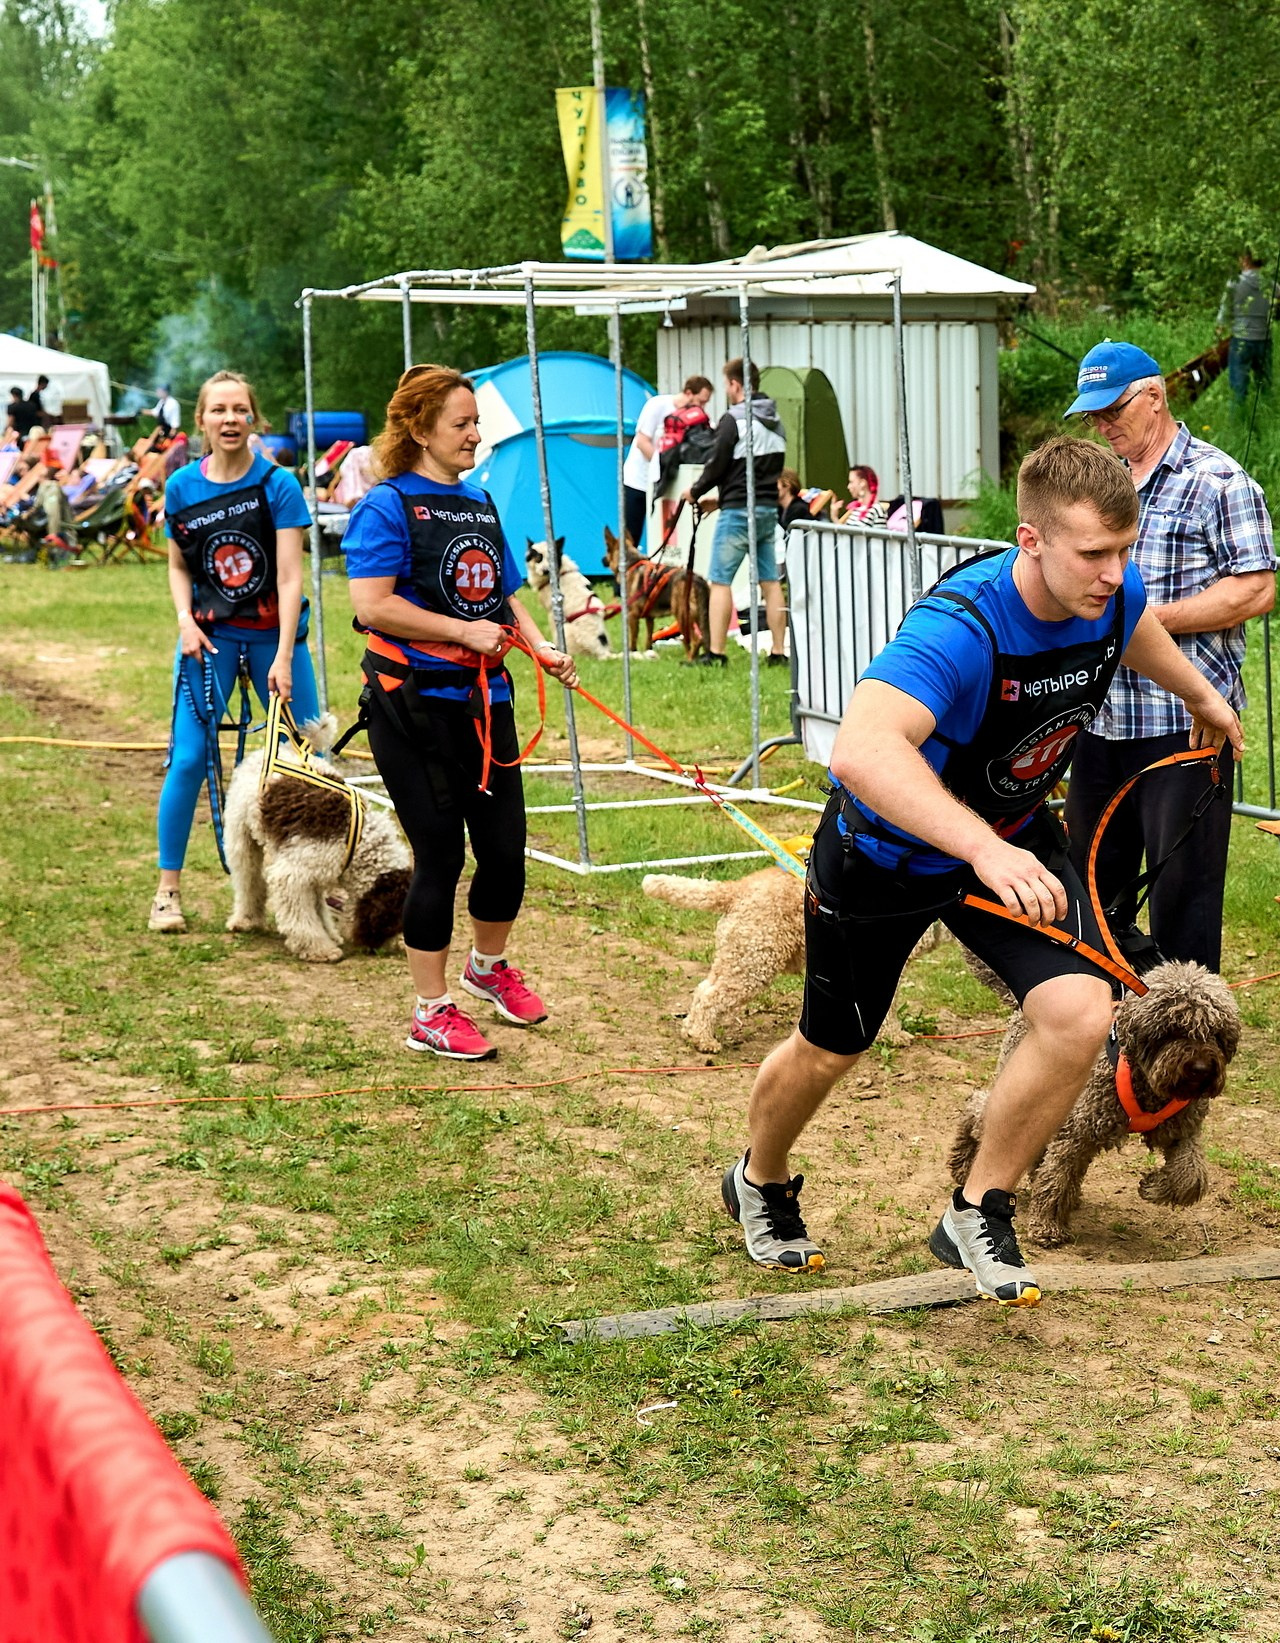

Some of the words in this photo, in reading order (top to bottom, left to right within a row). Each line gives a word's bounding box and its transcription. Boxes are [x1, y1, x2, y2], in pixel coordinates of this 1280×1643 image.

[228, 498, 260, 517] лапы
[445, 539, 472, 576] RUSSIAN
[456, 562, 495, 589] 212
[472, 597, 498, 612] TRAIL
[1024, 669, 1089, 698] четыре
[1012, 732, 1078, 769] 211
[998, 776, 1020, 791] DOG
